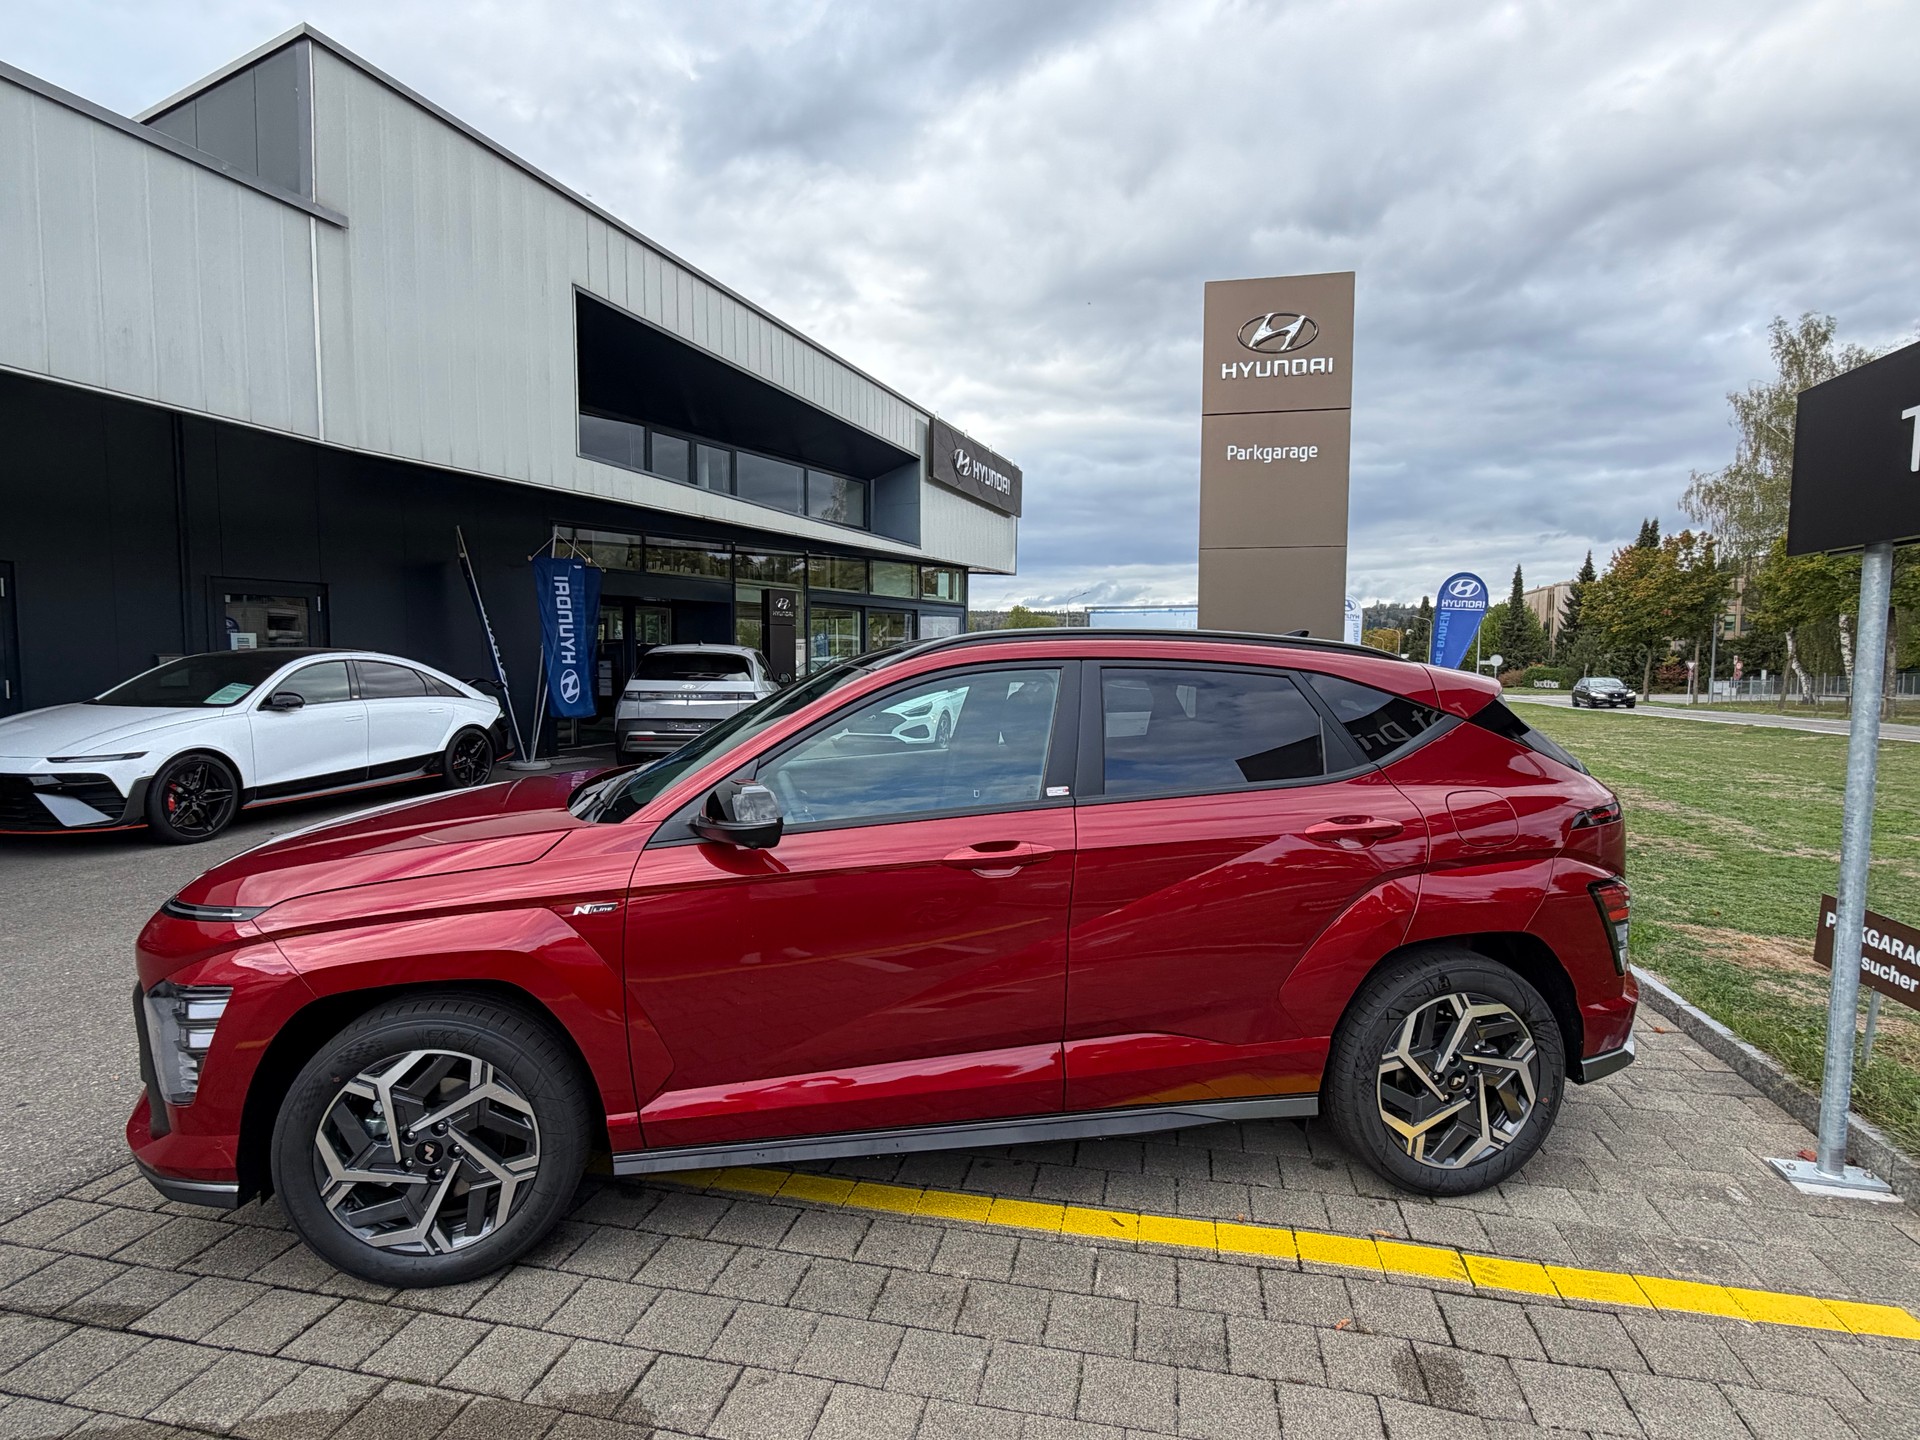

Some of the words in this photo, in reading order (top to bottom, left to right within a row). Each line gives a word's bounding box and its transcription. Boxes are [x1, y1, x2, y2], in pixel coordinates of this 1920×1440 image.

[1221, 357, 1334, 380] HYUNDAI
[1227, 444, 1318, 463] Parkgarage
[972, 460, 1011, 496] HYUNDAI
[553, 576, 577, 664] HYUNDAI
[1441, 599, 1485, 609] HYUNDAI
[1436, 612, 1451, 648] BADEN
[1860, 957, 1919, 993] sucher
